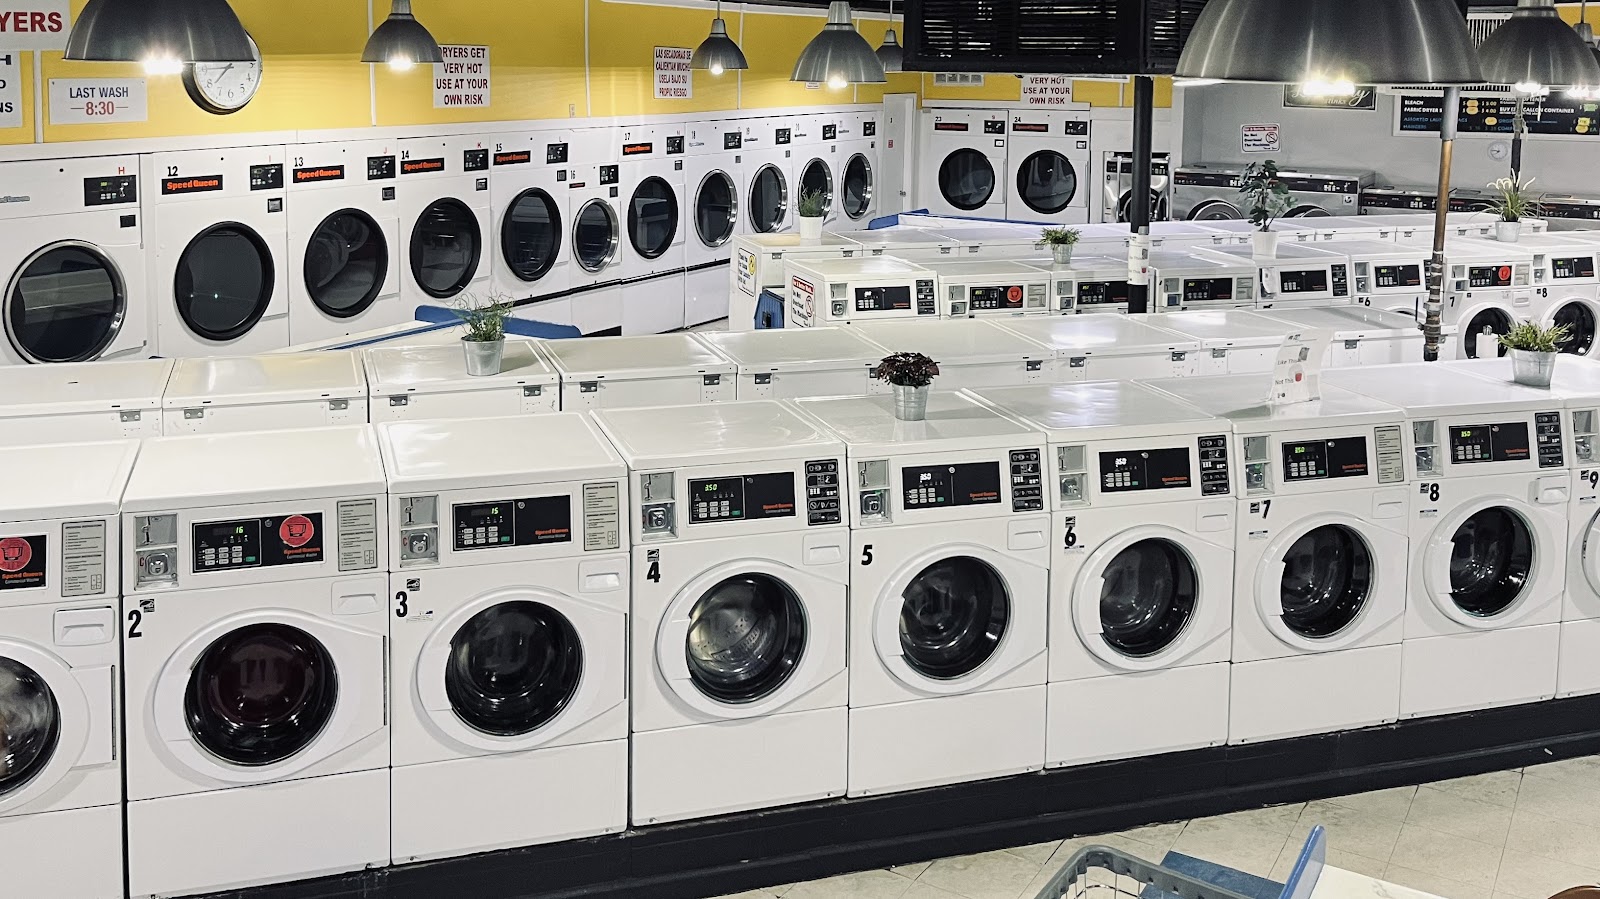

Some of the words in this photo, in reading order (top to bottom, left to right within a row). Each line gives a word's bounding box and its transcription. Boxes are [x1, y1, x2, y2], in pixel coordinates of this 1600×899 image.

[470, 47, 486, 59] GET
[443, 63, 464, 74] VERY
[466, 63, 482, 74] HOT
[436, 78, 452, 90] USE
[454, 78, 464, 90] AT
[466, 78, 488, 89] YOUR
[1030, 77, 1048, 85] VERY
[1050, 77, 1065, 85] HOT
[69, 87, 96, 99] LAST
[99, 87, 129, 98] WASH
[444, 94, 462, 105] OWN
[464, 94, 483, 105] RISK
[1029, 97, 1046, 105] OWN
[1047, 97, 1065, 105] RISK
[86, 101, 115, 116] 8:30
[496, 143, 503, 152] 15
[402, 150, 410, 160] 14
[294, 156, 304, 167] 13
[118, 166, 125, 175] H
[167, 165, 179, 177] 12
[297, 170, 319, 180] Speed
[319, 169, 341, 177] Queen
[167, 180, 193, 191] Speed
[193, 179, 219, 188] Queen
[1542, 287, 1548, 298] 8
[1364, 296, 1371, 307] 6
[1449, 296, 1455, 307] 7
[1589, 470, 1599, 490] 9
[1429, 482, 1440, 502] 8
[1261, 499, 1271, 520] 7
[235, 526, 244, 534] 16
[1064, 526, 1077, 547] 6
[861, 544, 873, 566] 5
[647, 561, 661, 583] 4
[395, 591, 408, 618] 3
[128, 609, 143, 639] 2
